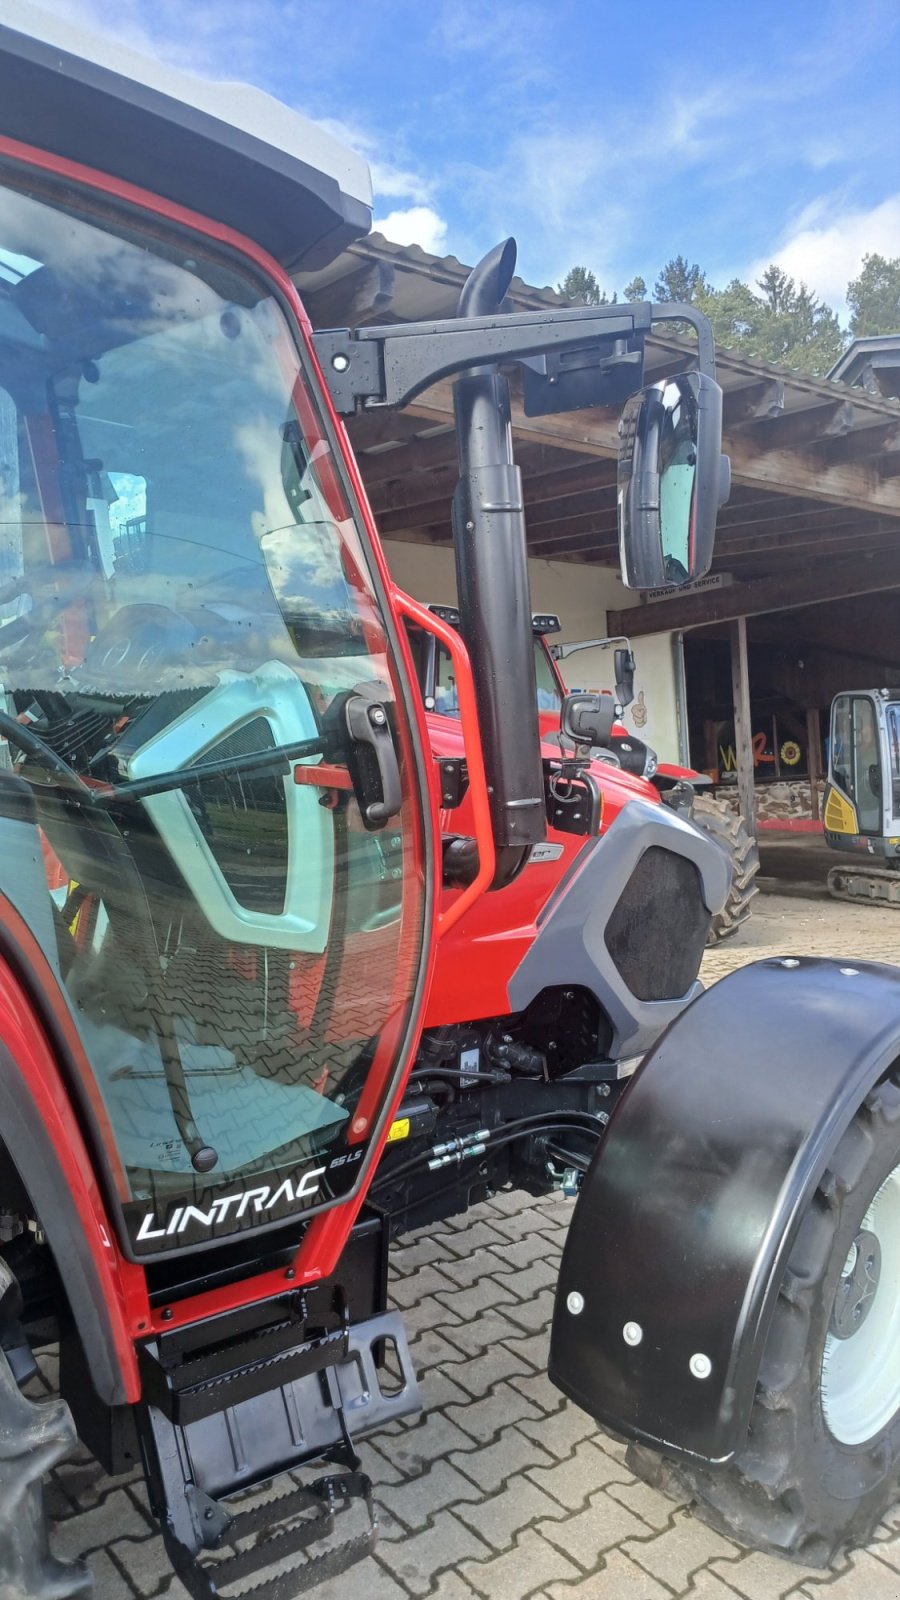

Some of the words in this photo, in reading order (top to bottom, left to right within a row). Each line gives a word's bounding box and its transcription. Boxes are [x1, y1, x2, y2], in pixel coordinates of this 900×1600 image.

[649, 588, 676, 599] VERKAUF
[694, 576, 720, 588] SERVICE
[330, 1154, 348, 1168] 65
[346, 1149, 363, 1163] LS
[136, 1166, 327, 1241] LINTRAC
